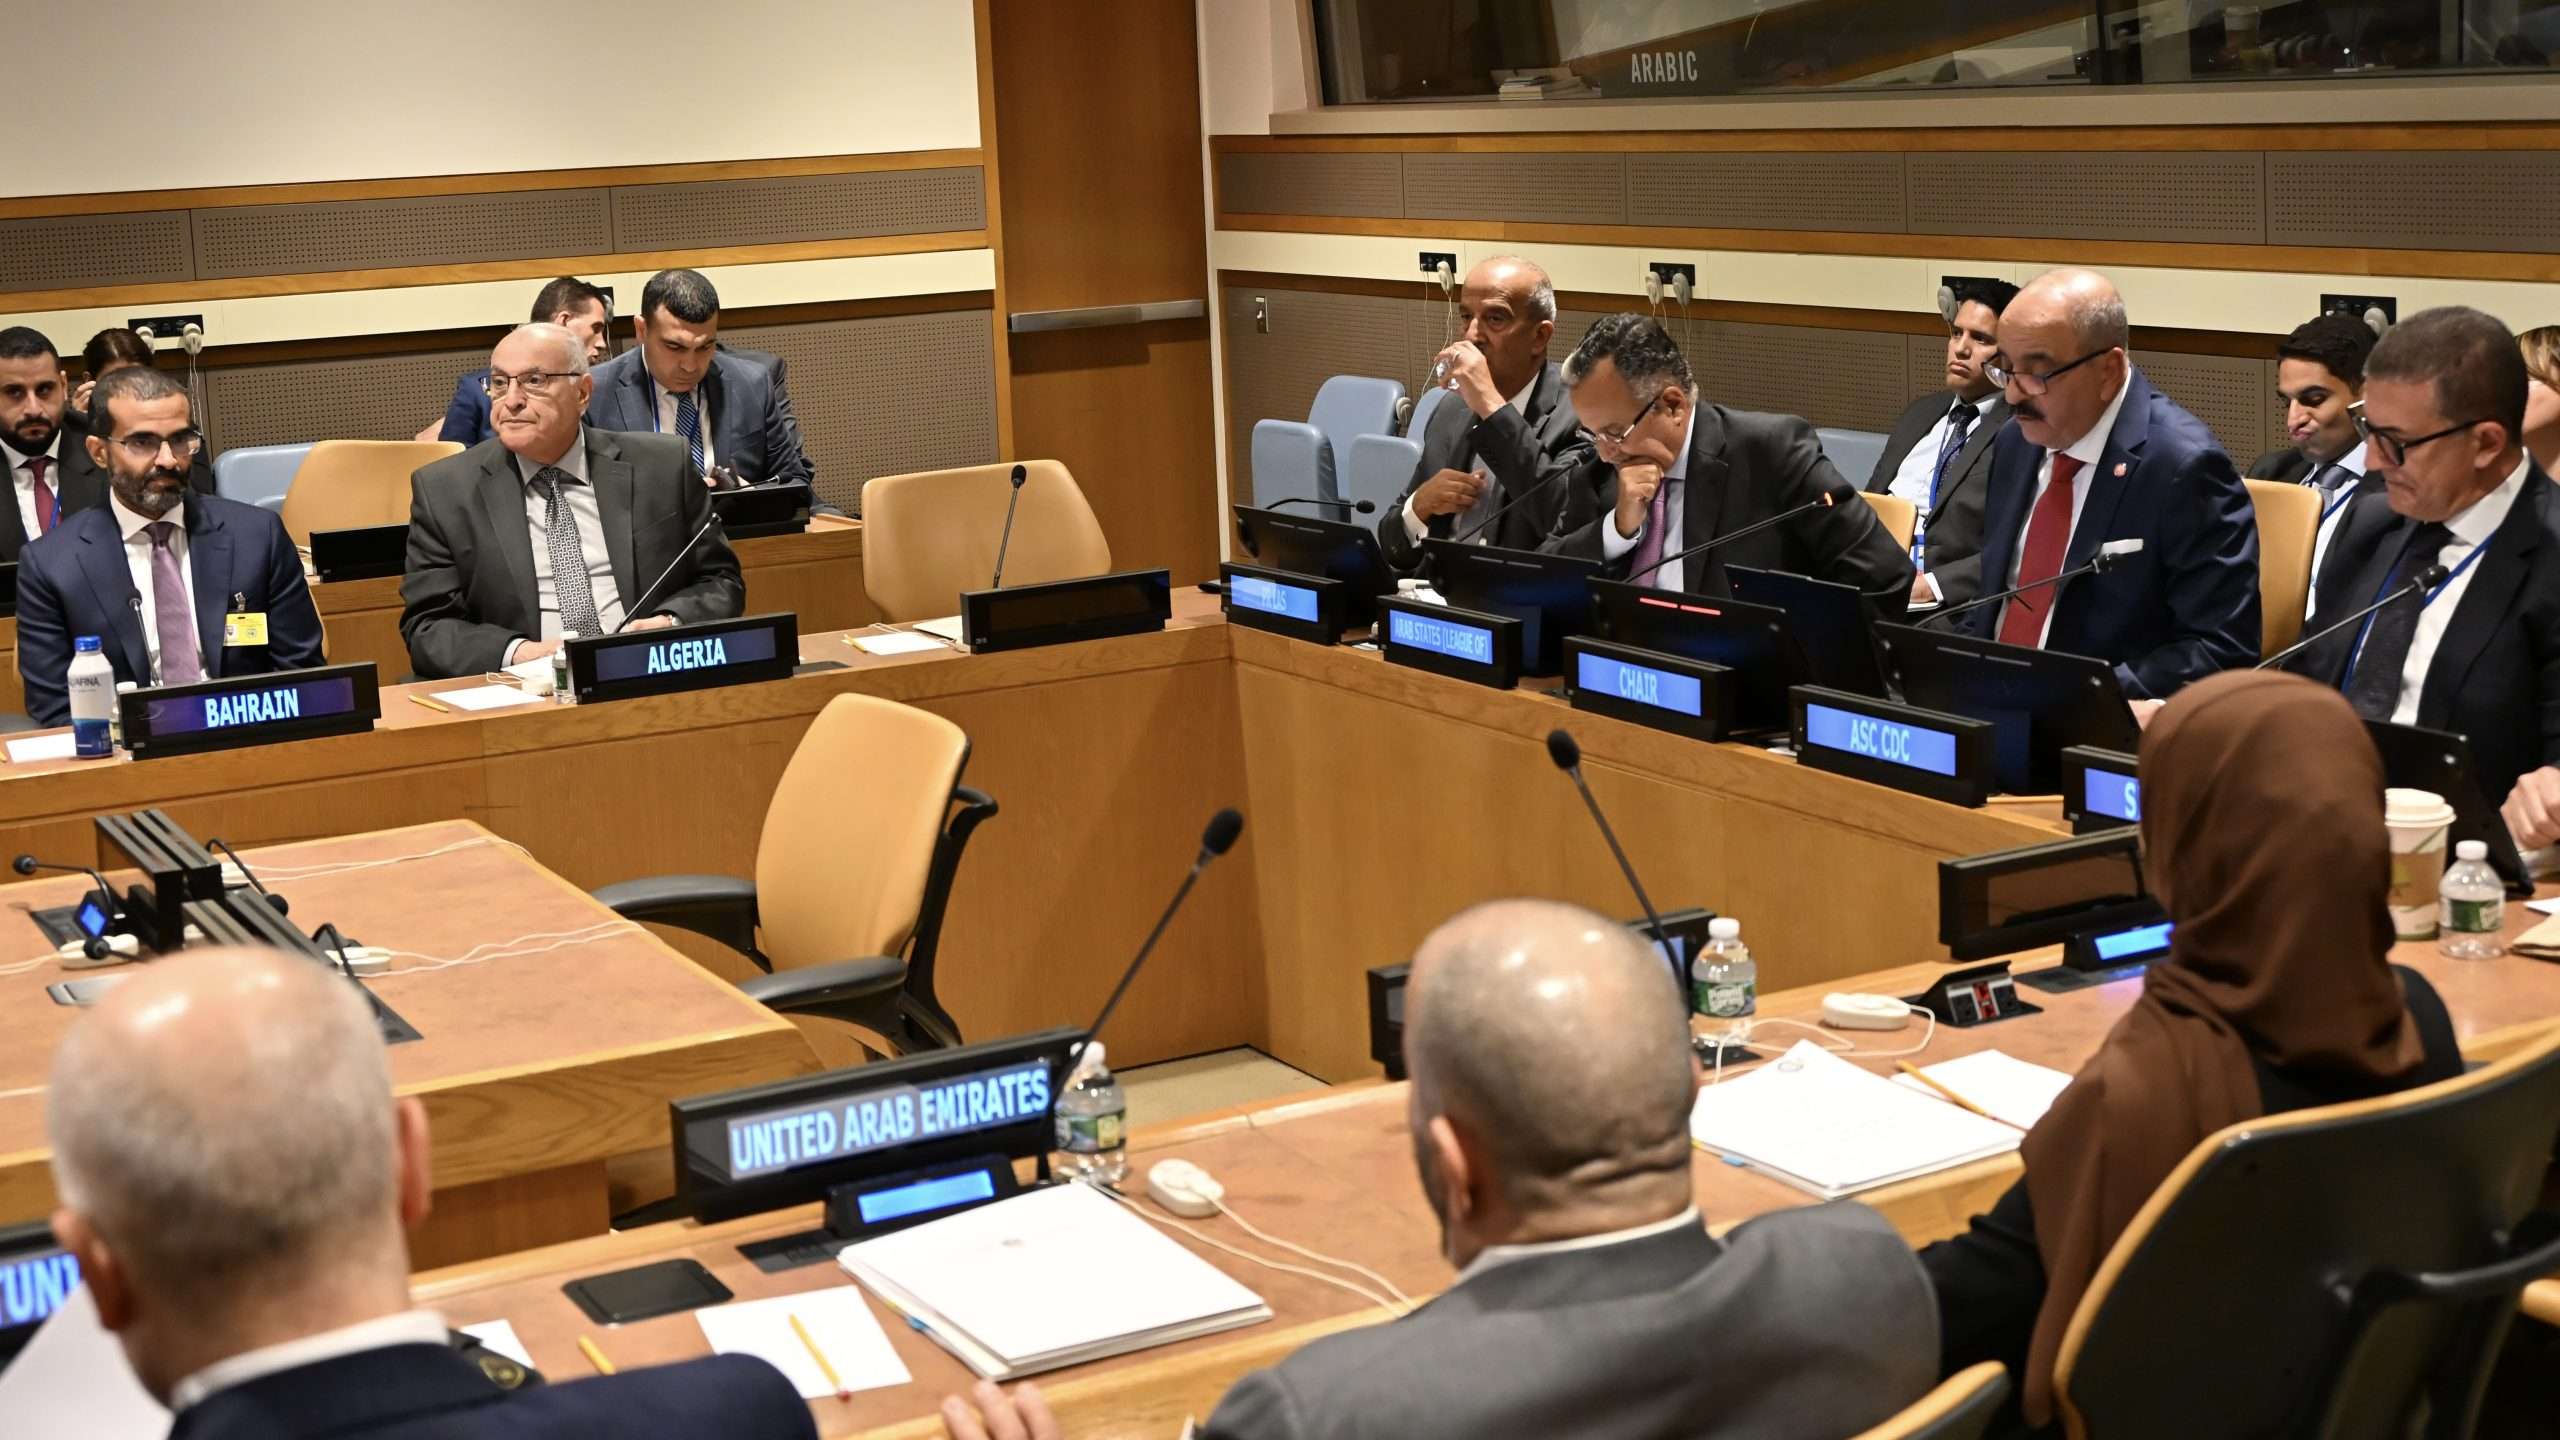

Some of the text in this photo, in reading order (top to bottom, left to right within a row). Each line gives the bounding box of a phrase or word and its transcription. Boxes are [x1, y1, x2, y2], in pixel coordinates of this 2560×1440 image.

[1631, 51, 1698, 83] ARABIC
[1395, 616, 1414, 641] ARAB
[1414, 621, 1440, 646] STATES
[647, 638, 727, 674] ALGERIA
[1618, 666, 1658, 705] CHAIR
[205, 688, 299, 728] BAHRAIN
[1849, 719, 1910, 763] ASC CDC
[732, 1115, 836, 1170] UNITED
[842, 1096, 917, 1149] ARAB
[920, 1068, 1049, 1134] EMIRATES
